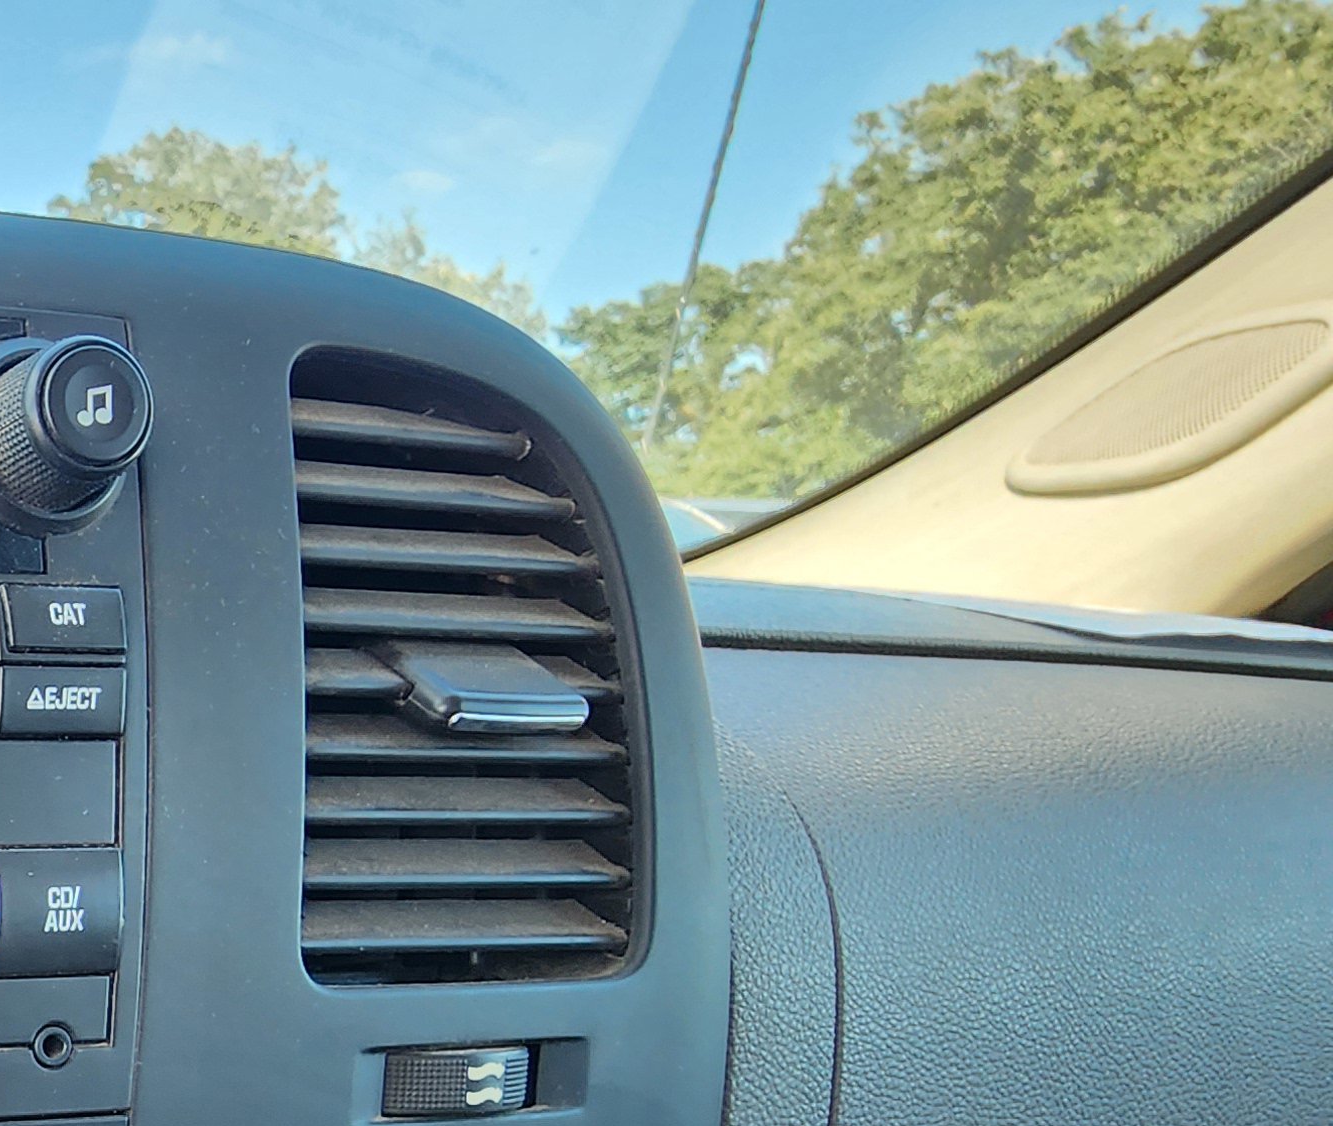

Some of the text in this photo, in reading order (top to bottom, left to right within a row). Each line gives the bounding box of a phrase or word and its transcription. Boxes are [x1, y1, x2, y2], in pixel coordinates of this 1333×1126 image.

[49, 602, 87, 627] CAT
[44, 686, 103, 710] EJECT
[47, 885, 82, 909] CD/
[44, 908, 85, 934] AUX
